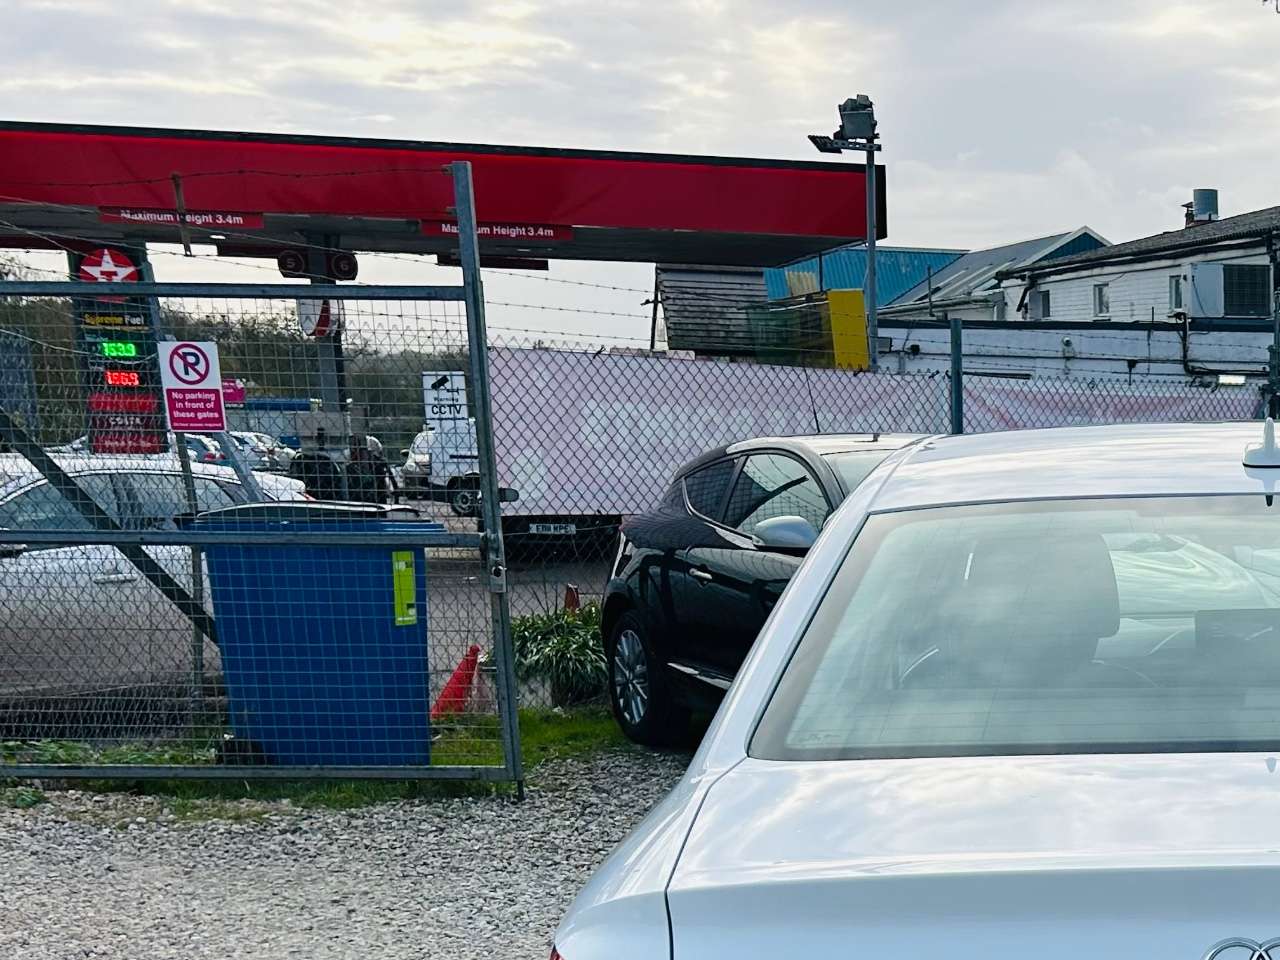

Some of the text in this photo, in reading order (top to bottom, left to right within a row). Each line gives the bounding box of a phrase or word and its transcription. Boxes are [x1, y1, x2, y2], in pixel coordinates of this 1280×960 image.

[121, 209, 174, 222] Maximum
[215, 214, 244, 225] 3.4m
[493, 225, 526, 238] Height
[527, 226, 554, 237] 3.4m
[125, 314, 144, 325] Fuel
[172, 391, 184, 399] No
[185, 391, 216, 401] parking
[175, 401, 215, 409] in front of
[431, 404, 462, 415] CCTV
[173, 410, 219, 420] these gates
